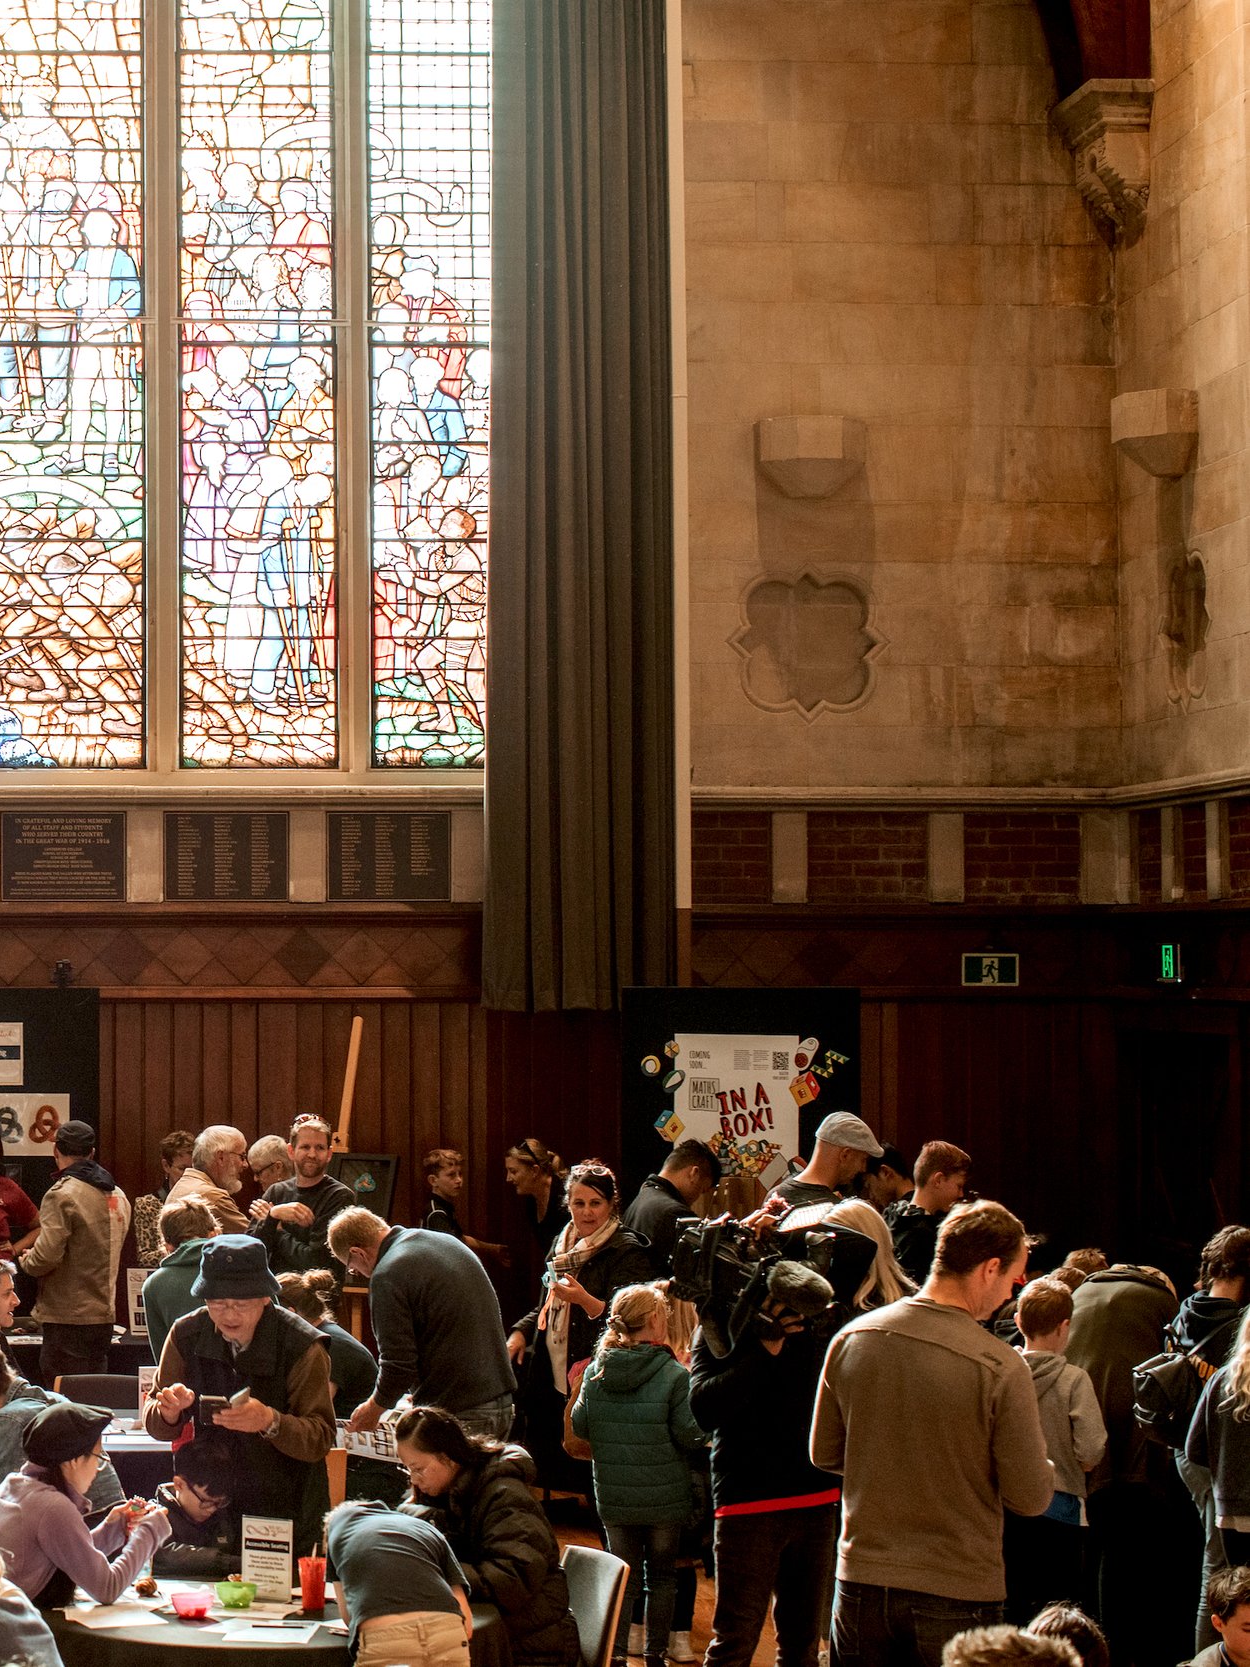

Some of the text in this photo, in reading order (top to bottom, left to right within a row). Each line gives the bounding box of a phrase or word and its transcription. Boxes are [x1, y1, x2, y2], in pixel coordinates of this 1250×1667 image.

[689, 1051, 710, 1059] COMING
[692, 1081, 716, 1094] MATHS
[692, 1095, 714, 1109] CRAFT
[715, 1082, 770, 1116] IN A
[720, 1107, 774, 1139] BOX!
[271, 1543, 288, 1551] Seating
